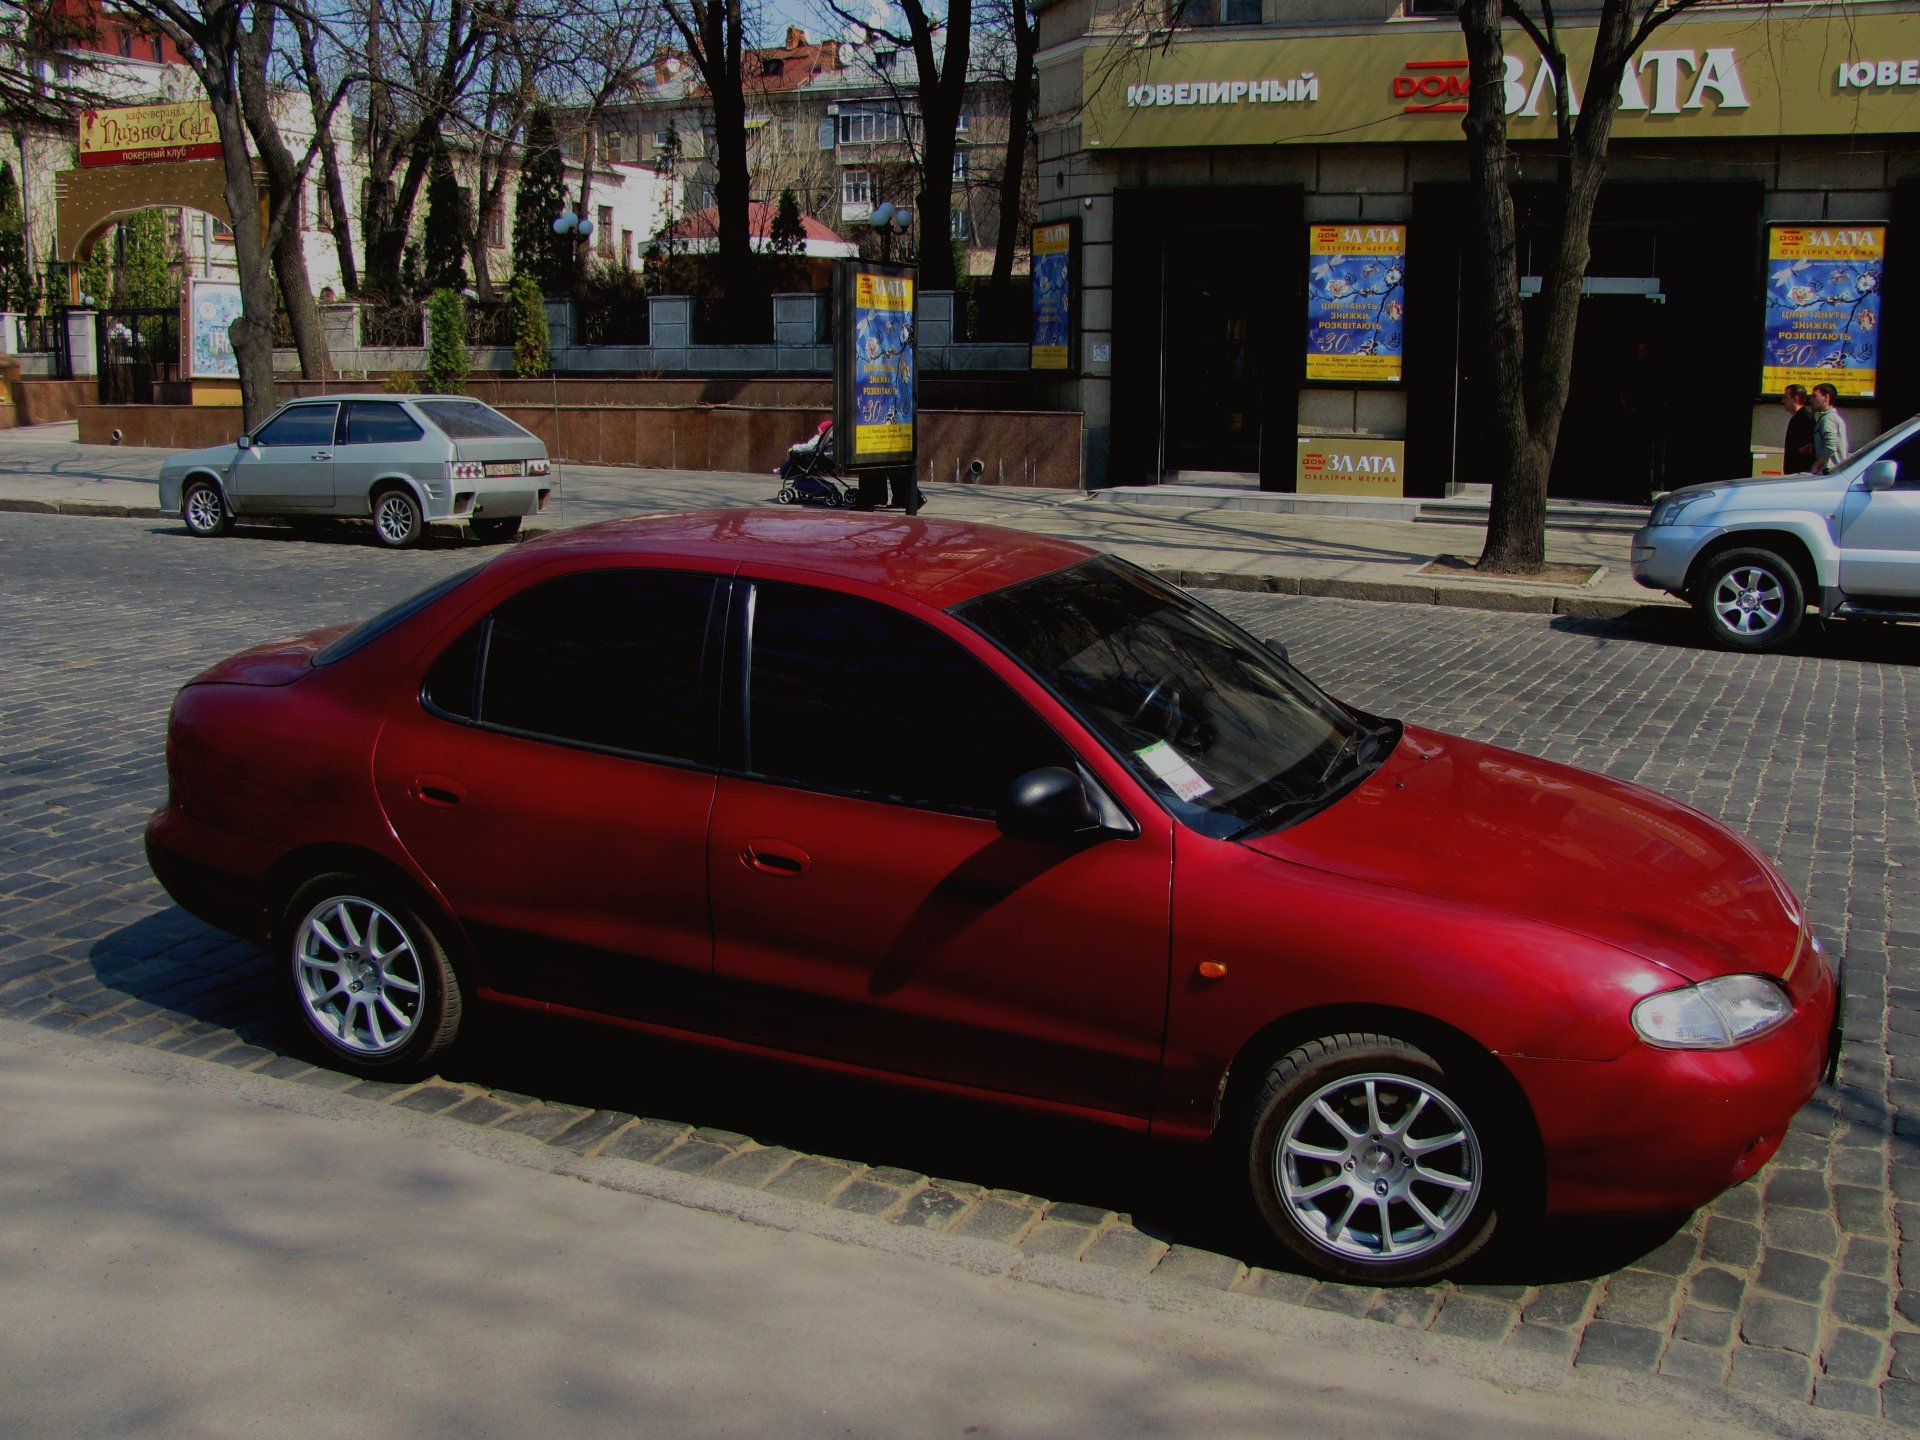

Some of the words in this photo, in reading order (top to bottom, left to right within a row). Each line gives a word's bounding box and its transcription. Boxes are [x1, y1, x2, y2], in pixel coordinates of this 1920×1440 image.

[1127, 73, 1318, 107] ЮВЕЛИРНЫЙ
[126, 107, 186, 123] кафе-веранда
[123, 148, 165, 161] покерный
[166, 146, 187, 160] клуб
[1340, 228, 1400, 243] ЗЛАТА
[1805, 230, 1874, 246] ЗЛАТА
[874, 277, 908, 297] ЗЛАТА
[1319, 321, 1382, 330] РОЗКВІТАЮТЬ
[1792, 321, 1837, 330] ЗНИЖКИ
[1778, 332, 1852, 340] РОЗКВІТАЮТЬ
[1327, 454, 1396, 473] ЗЛАТА
[1359, 475, 1397, 483] МЕРЕЖА
